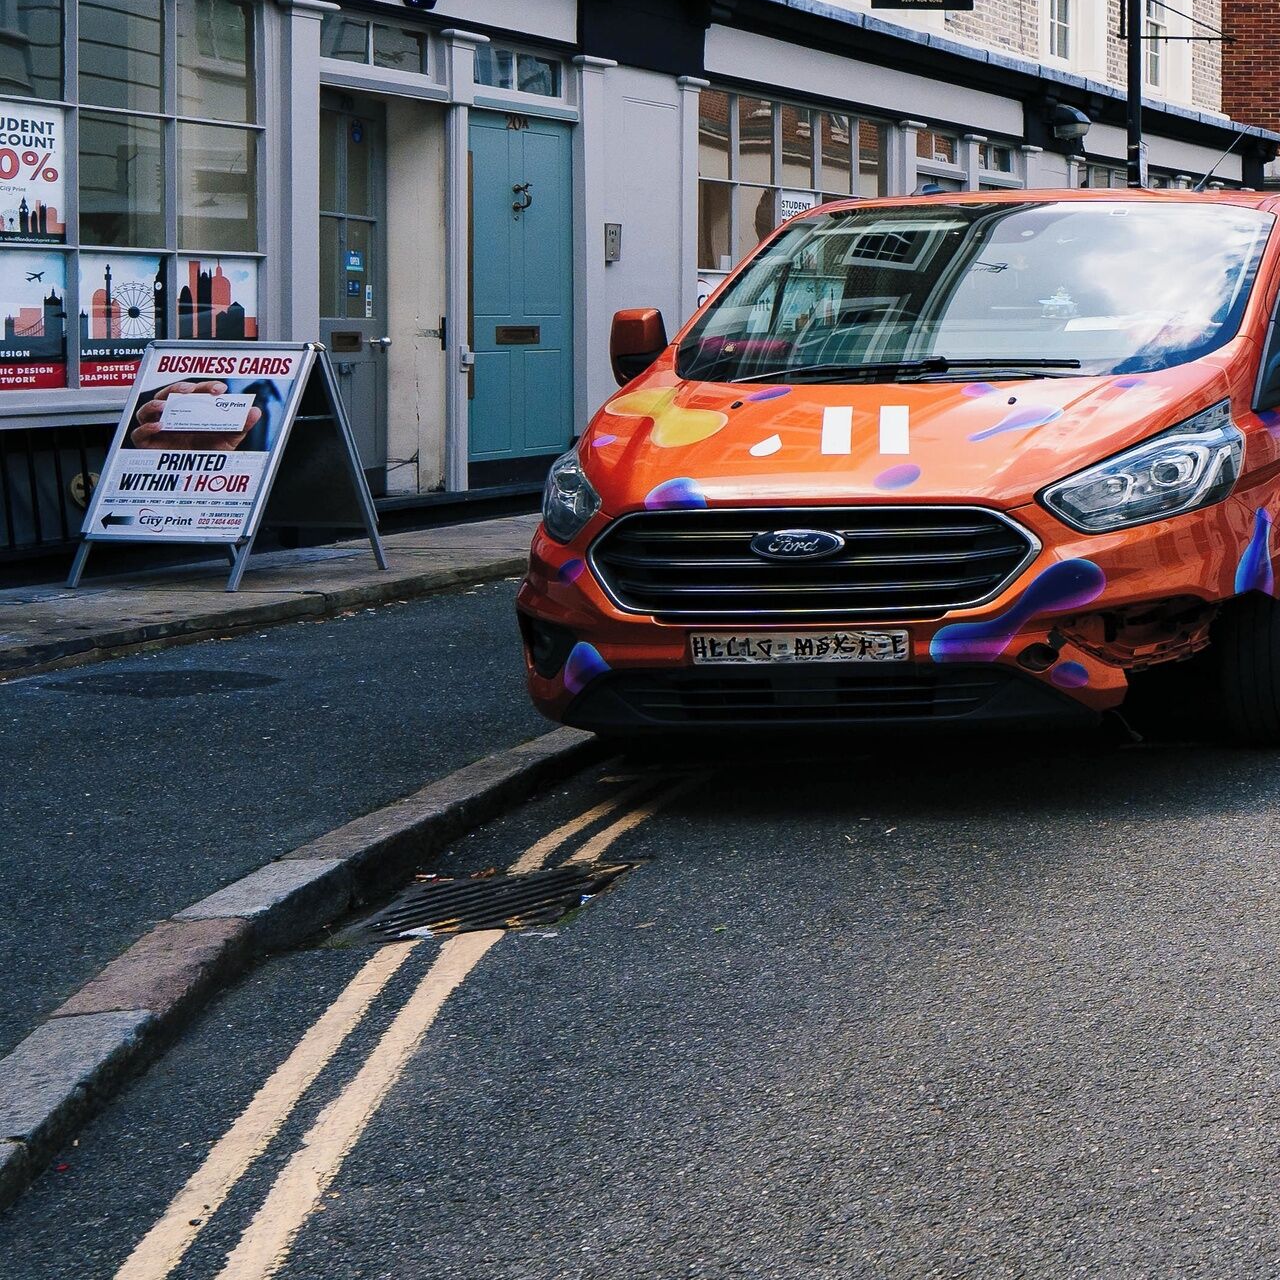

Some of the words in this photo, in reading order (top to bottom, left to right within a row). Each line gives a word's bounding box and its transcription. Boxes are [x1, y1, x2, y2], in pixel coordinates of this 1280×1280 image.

[781, 200, 811, 210] STUDENT
[17, 367, 54, 375] DESIGN
[157, 356, 237, 374] BUSINESS
[238, 358, 293, 375] CARDS
[215, 401, 229, 409] City
[157, 453, 227, 471] PRINTED
[119, 473, 180, 491] WITHIN
[183, 474, 193, 492] 1
[194, 475, 251, 493] HOUR
[138, 515, 163, 526] City
[164, 515, 192, 526] Print
[768, 533, 820, 553] Ford
